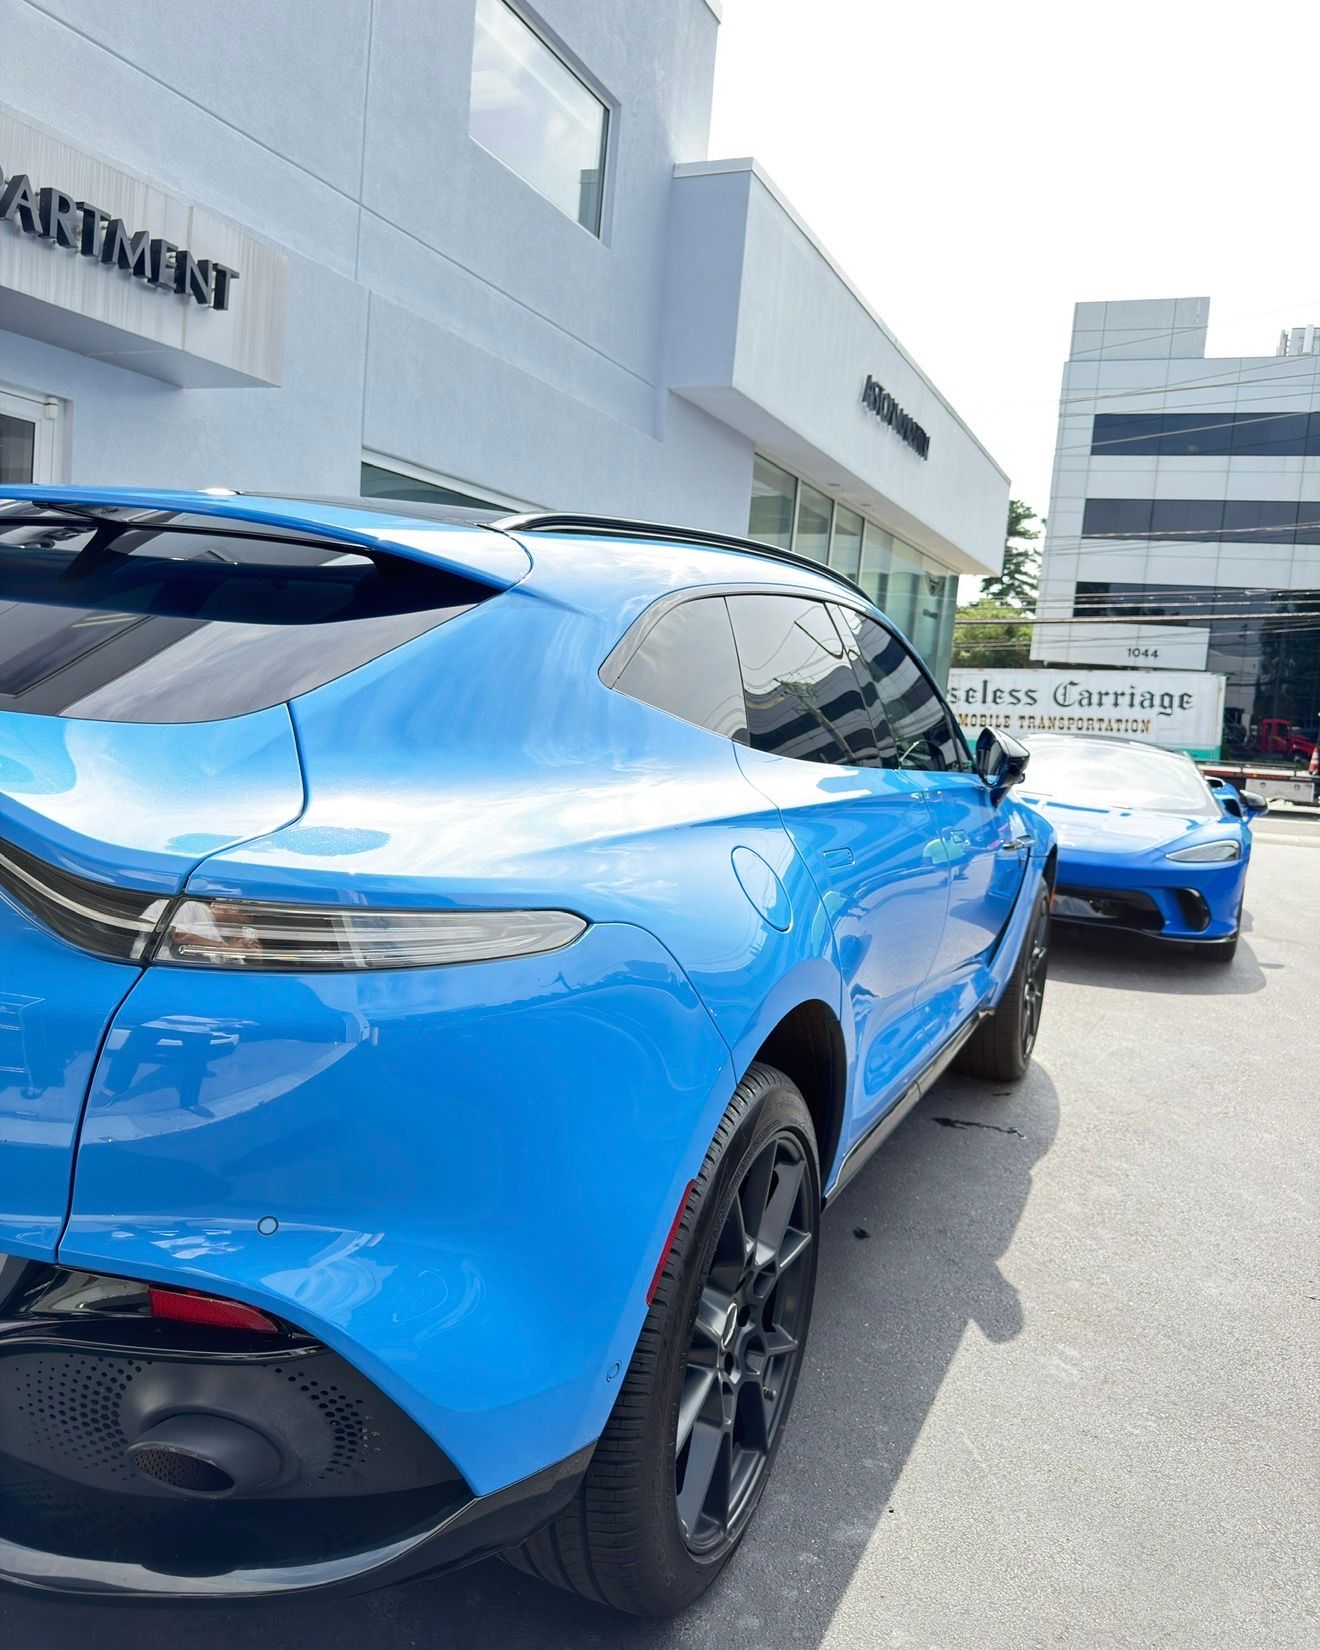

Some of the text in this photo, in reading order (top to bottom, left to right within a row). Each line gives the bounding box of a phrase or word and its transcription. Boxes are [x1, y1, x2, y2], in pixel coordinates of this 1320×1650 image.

[0, 165, 240, 311] ARTMENT
[1127, 647, 1158, 659] 1044
[946, 679, 1195, 716] seless Carriage
[1018, 714, 1152, 734] TRANSPORTATION
